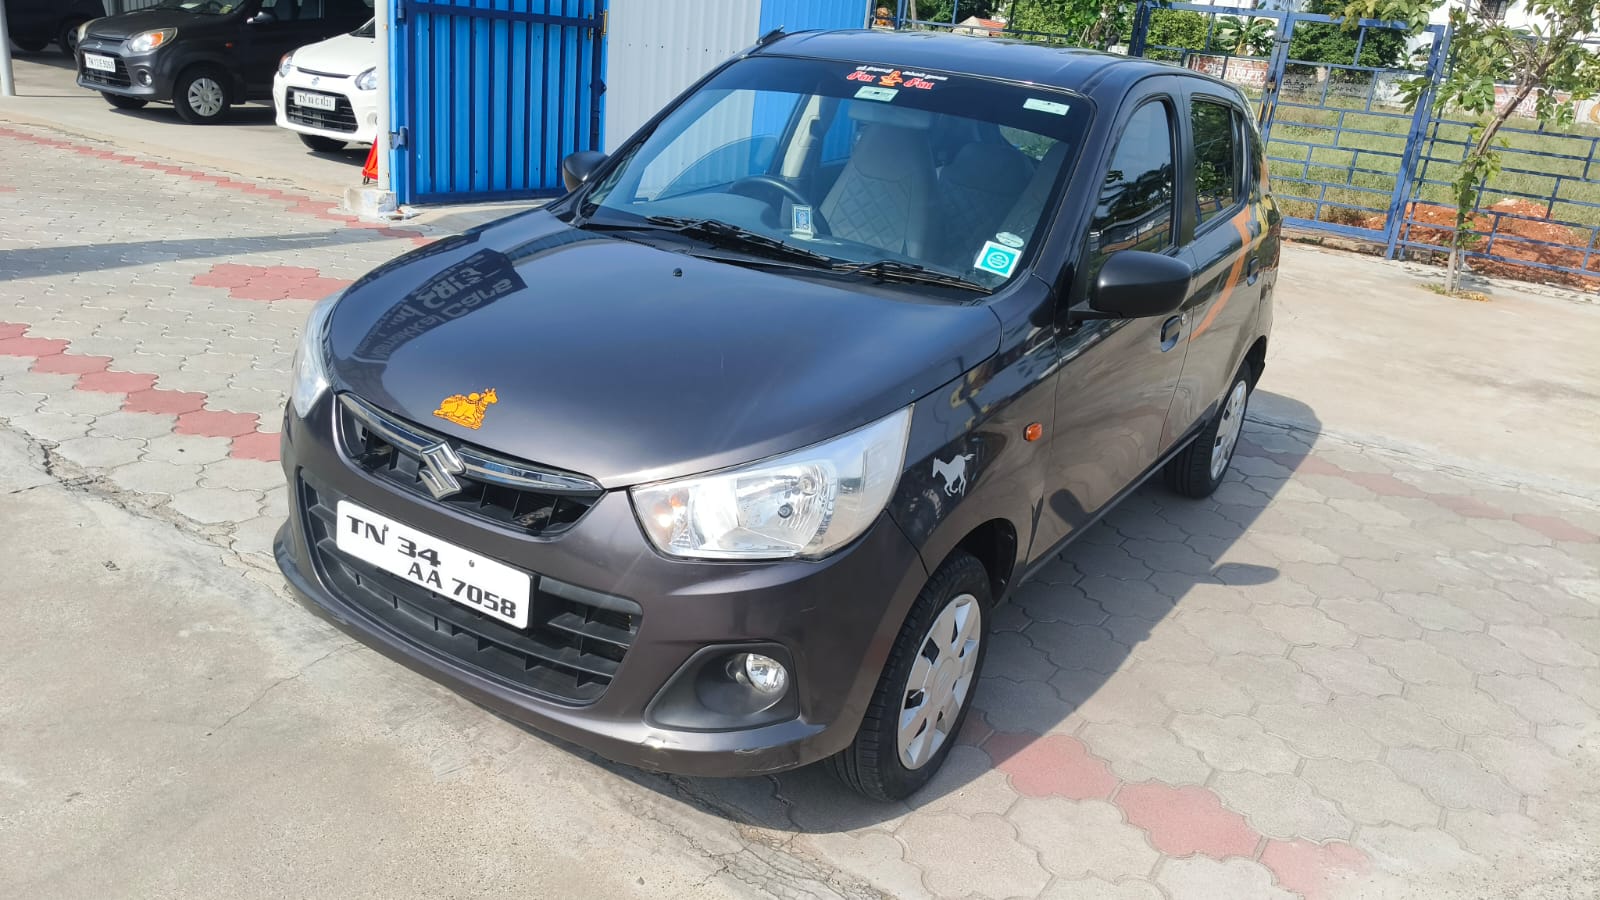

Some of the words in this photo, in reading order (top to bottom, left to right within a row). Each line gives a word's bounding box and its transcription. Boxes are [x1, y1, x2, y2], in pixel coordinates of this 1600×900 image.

[346, 514, 387, 546] TN
[397, 536, 441, 568] 34
[407, 562, 443, 589] AA
[452, 577, 517, 619] 7058
